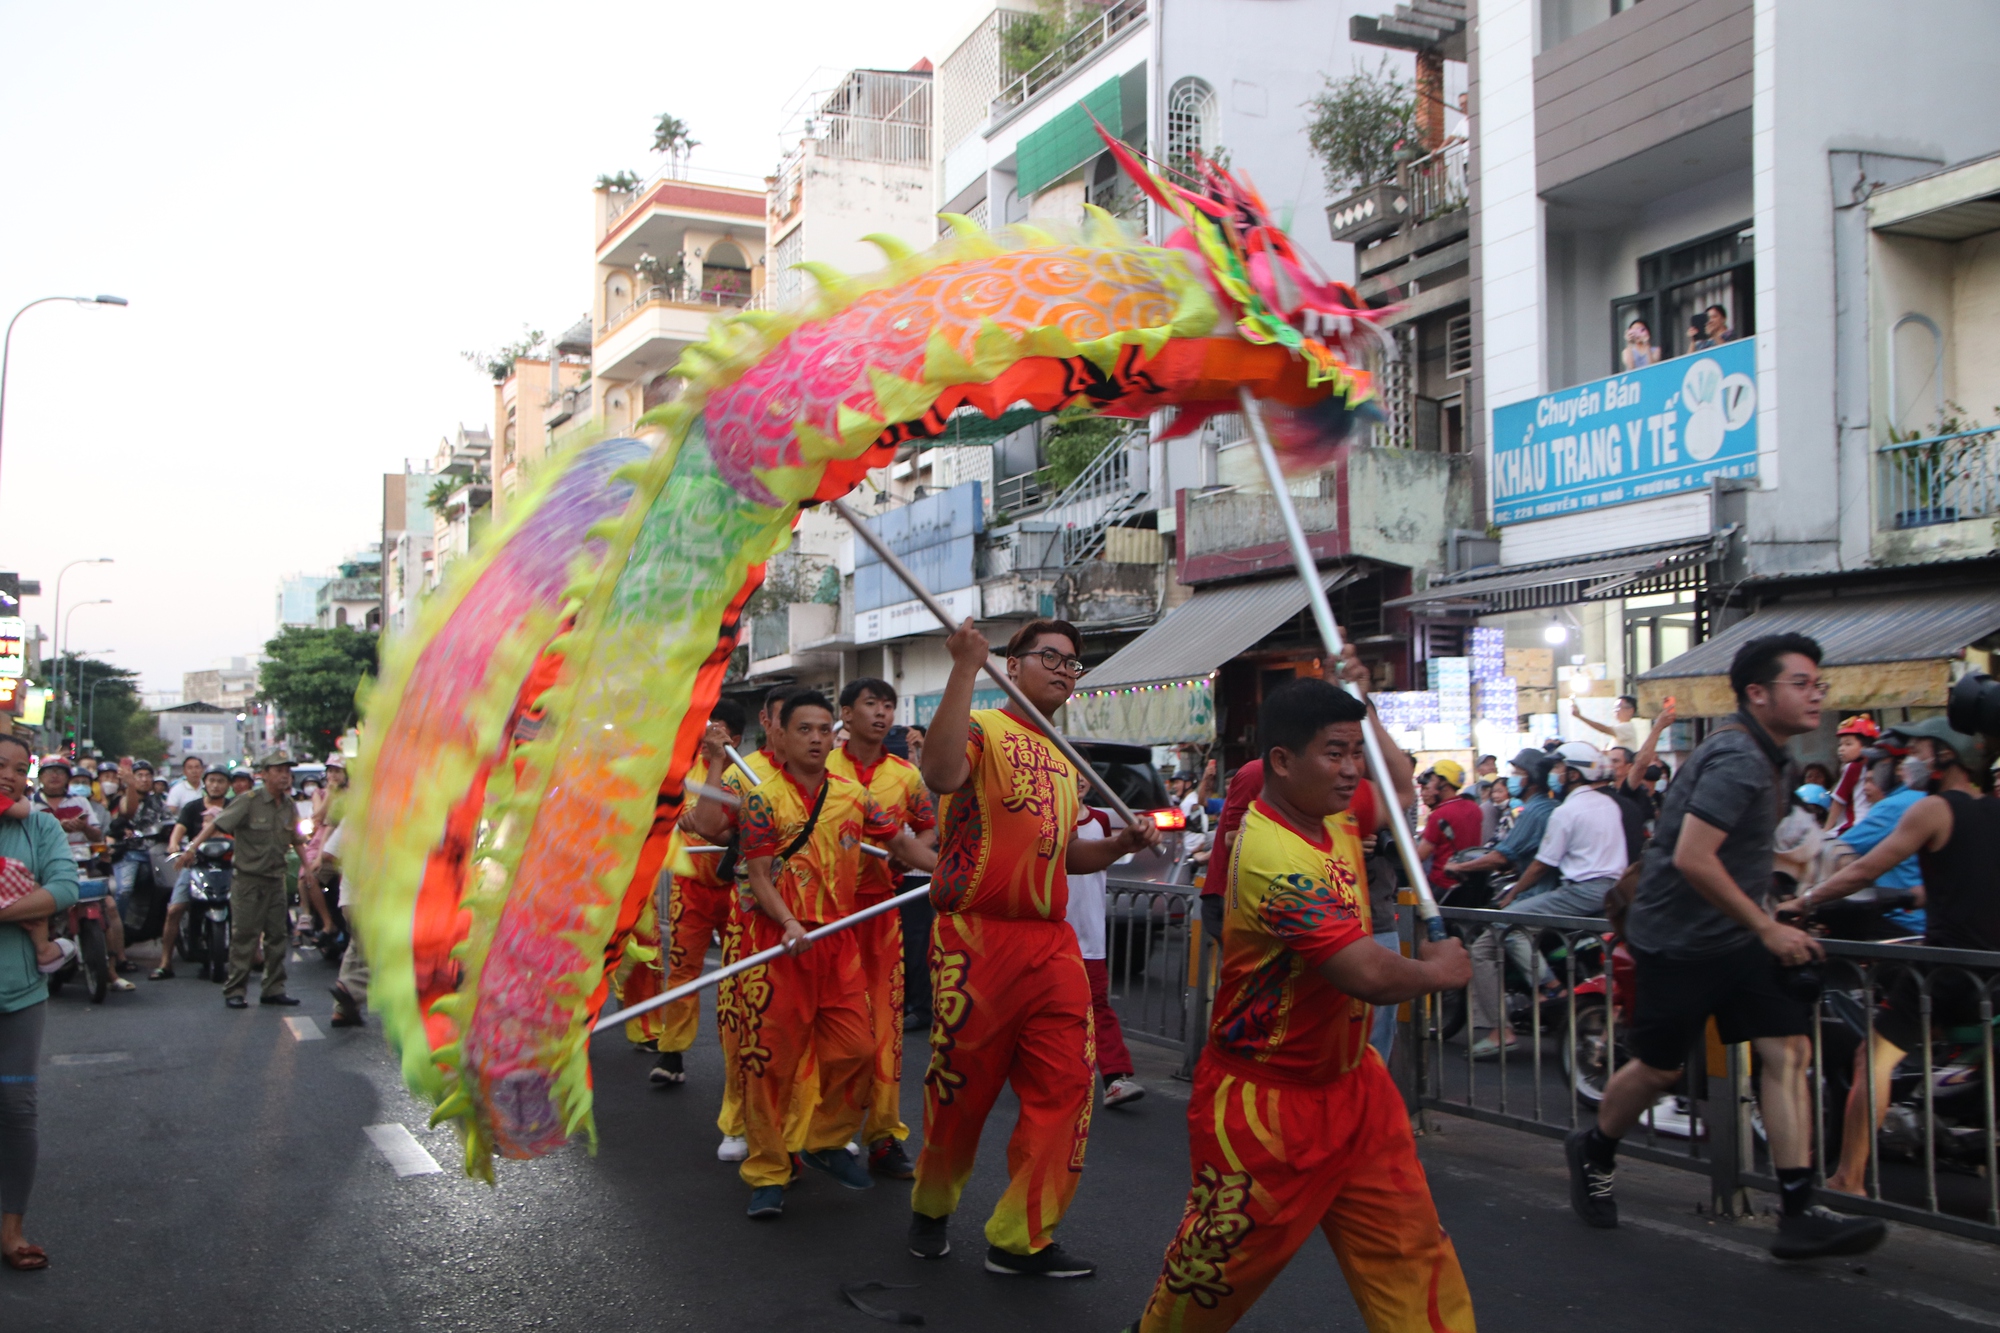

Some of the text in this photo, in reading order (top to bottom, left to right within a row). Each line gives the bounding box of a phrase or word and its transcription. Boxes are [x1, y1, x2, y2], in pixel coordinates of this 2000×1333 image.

[1536, 376, 1640, 428] Chuyên Bán
[1494, 391, 1680, 498] KHẨU TRANG Y TẾ
[1683, 474, 1693, 487] 4
[1743, 461, 1756, 476] 11
[1031, 741, 1048, 756] Fu
[1037, 754, 1067, 776] Ying
